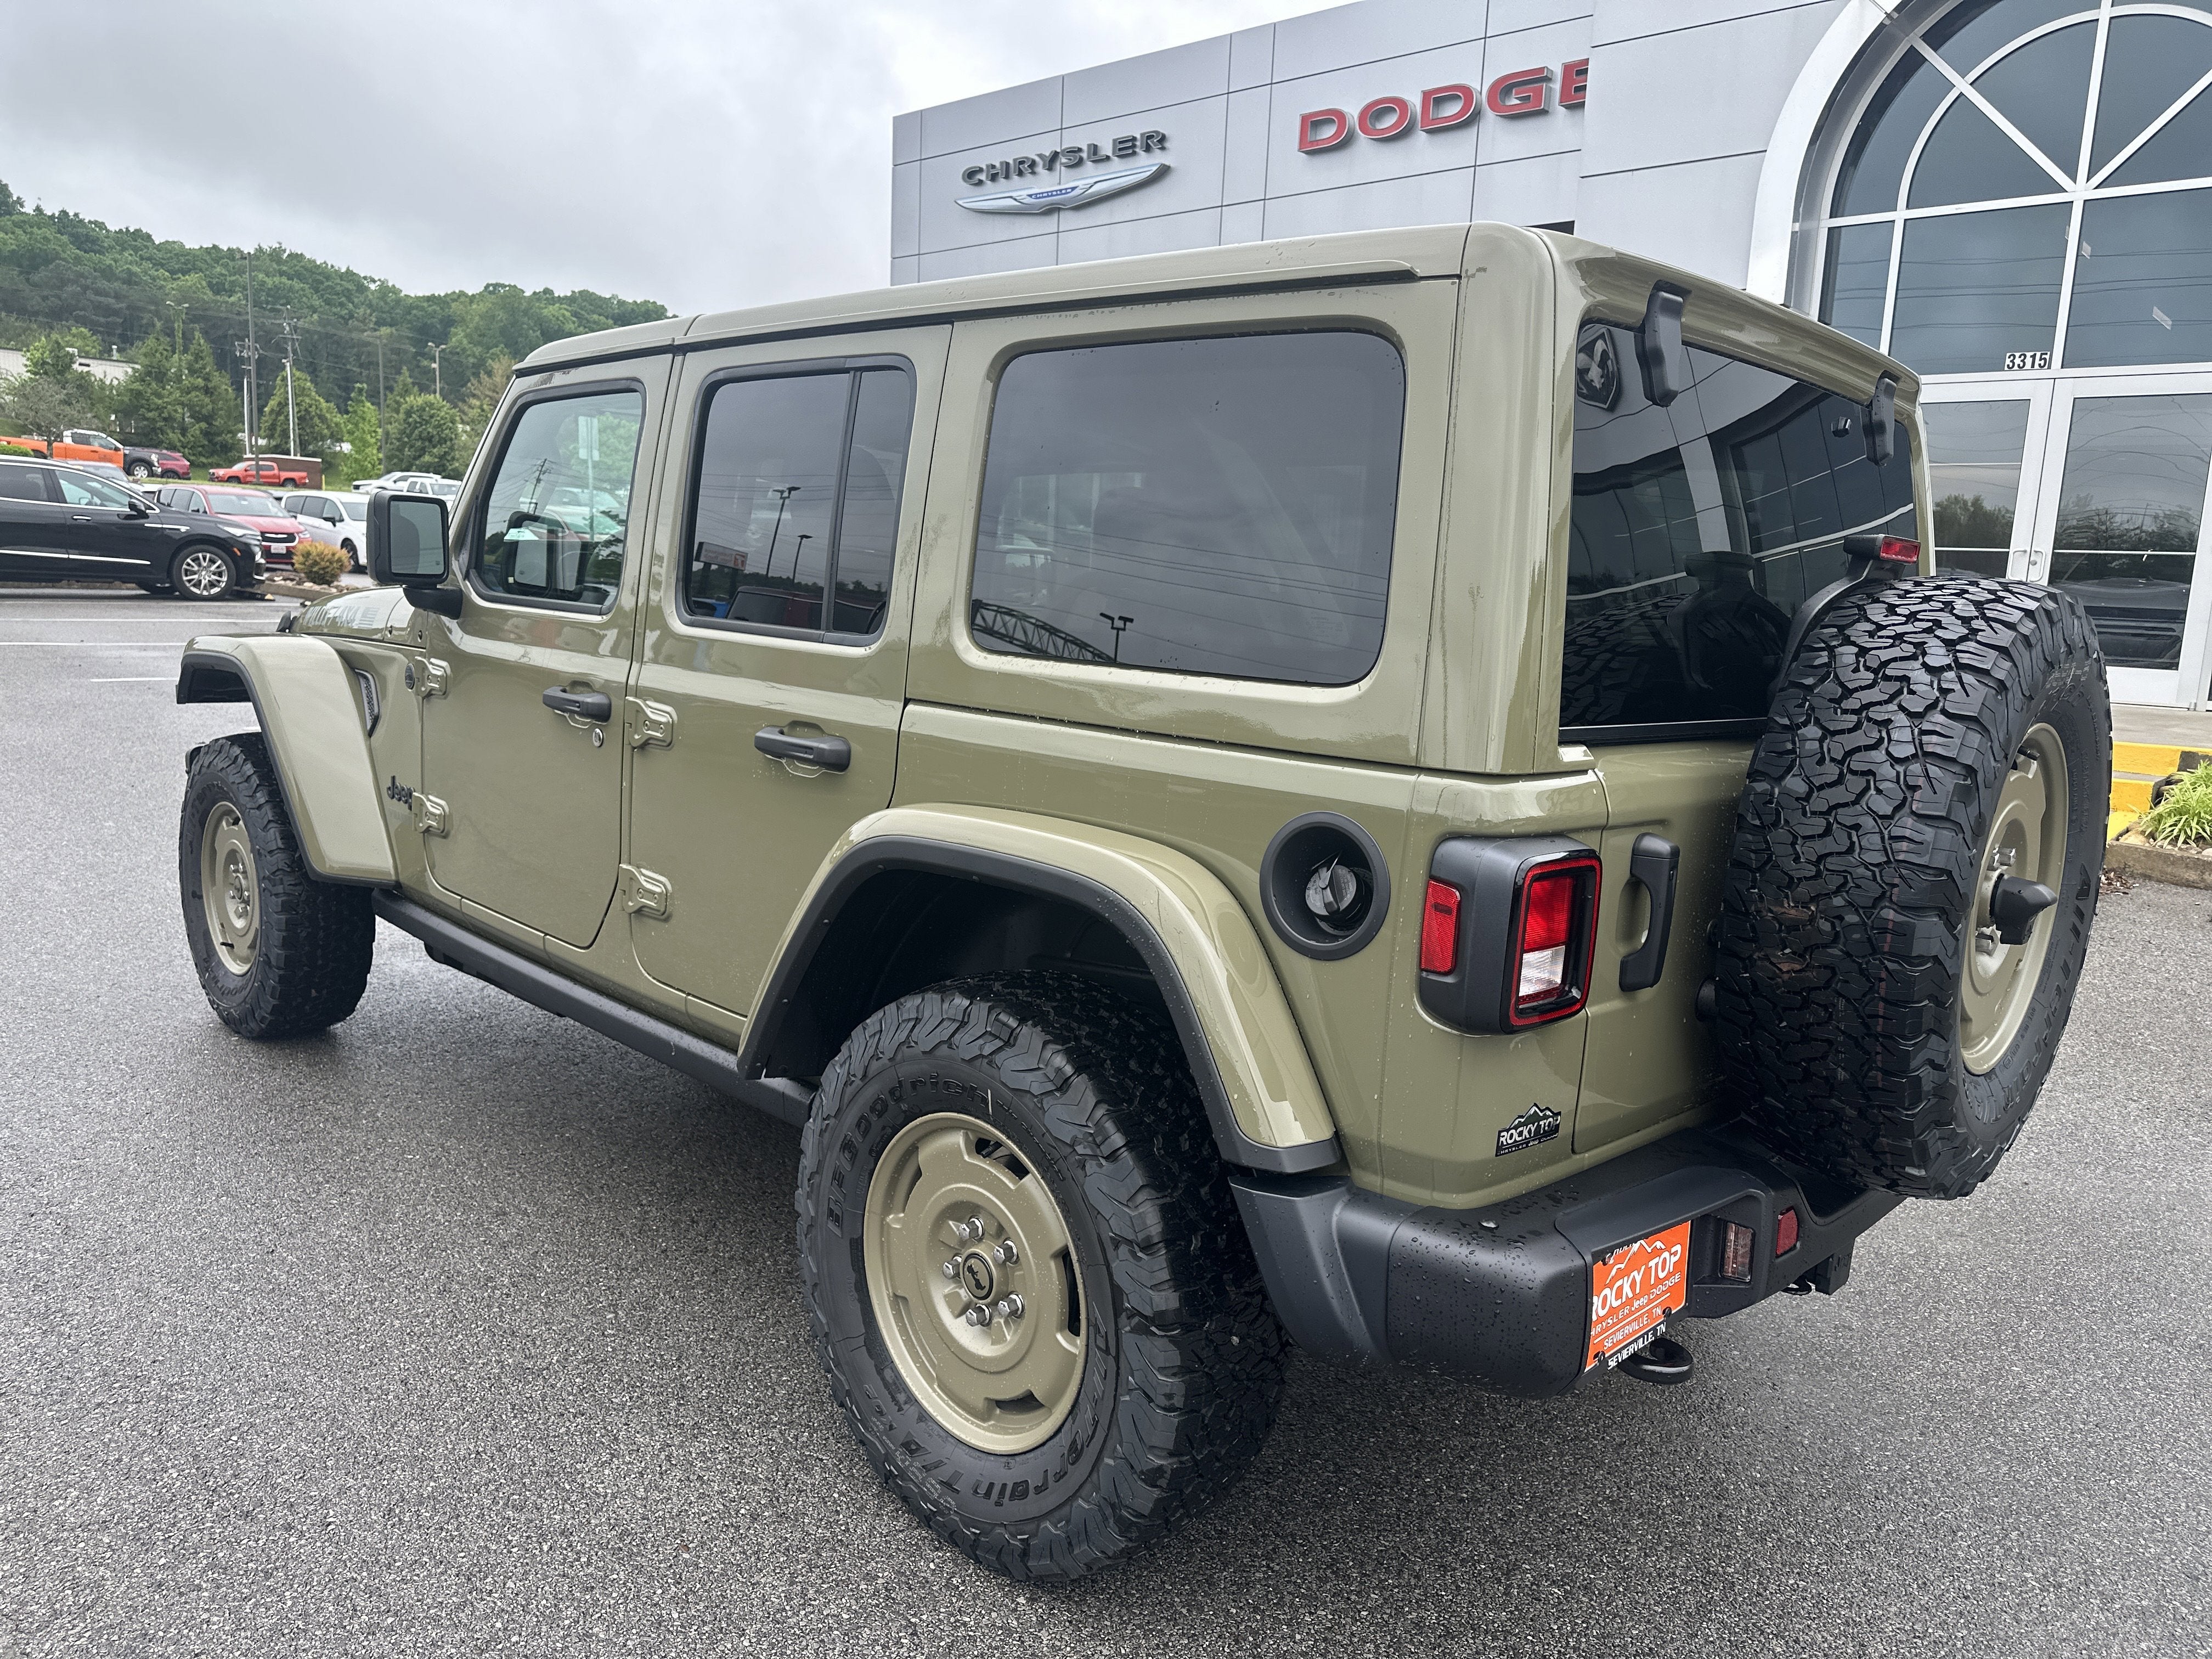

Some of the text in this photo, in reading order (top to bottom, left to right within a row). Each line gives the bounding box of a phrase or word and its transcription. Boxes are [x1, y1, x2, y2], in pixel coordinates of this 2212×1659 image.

[1297, 58, 1589, 154] DODGE
[962, 130, 1166, 185] CHRYSLER
[1031, 188, 1073, 199] CHRYSLER
[2006, 352, 2049, 370] 3315
[387, 775, 415, 811] Jeep
[827, 1071, 989, 1238] BFGoodrich
[1499, 1122, 1538, 1146] ROCKY
[1539, 1115, 1561, 1134] TOP
[1590, 1272, 1681, 1339] HRYSLER Jeep DODGE
[1592, 1265, 1645, 1322] ROCKY
[1647, 1243, 1682, 1285] TOP
[1603, 1305, 1662, 1350] SEVIERVILLE, TN
[1607, 1321, 1667, 1370] SEVIERVILLE, TN
